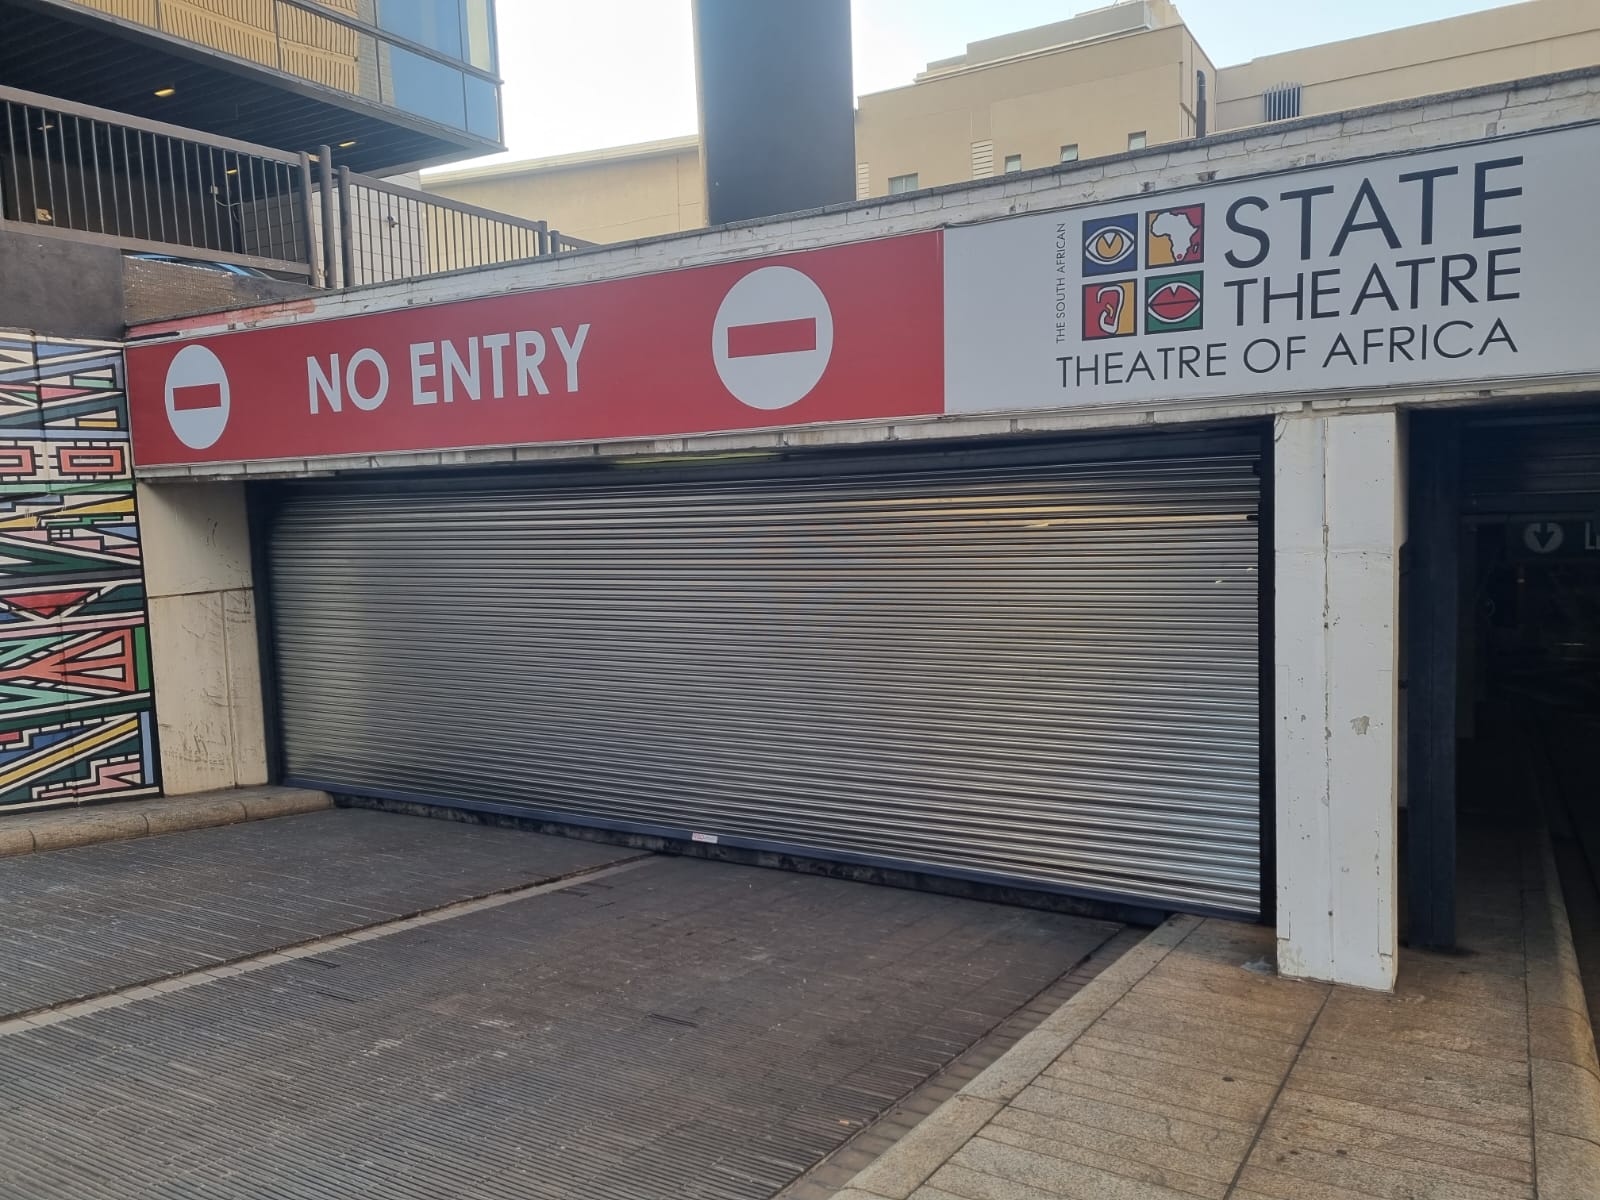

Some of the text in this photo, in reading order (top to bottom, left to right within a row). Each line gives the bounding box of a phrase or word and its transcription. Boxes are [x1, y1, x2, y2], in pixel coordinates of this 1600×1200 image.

[1224, 155, 1524, 269] STATE
[1056, 223, 1066, 344] THE SOUTH AFRICAN
[1224, 247, 1521, 326] THEATRE
[306, 323, 592, 415] NO ENTRY
[1056, 317, 1519, 388] THEATRE OF AFRICA
